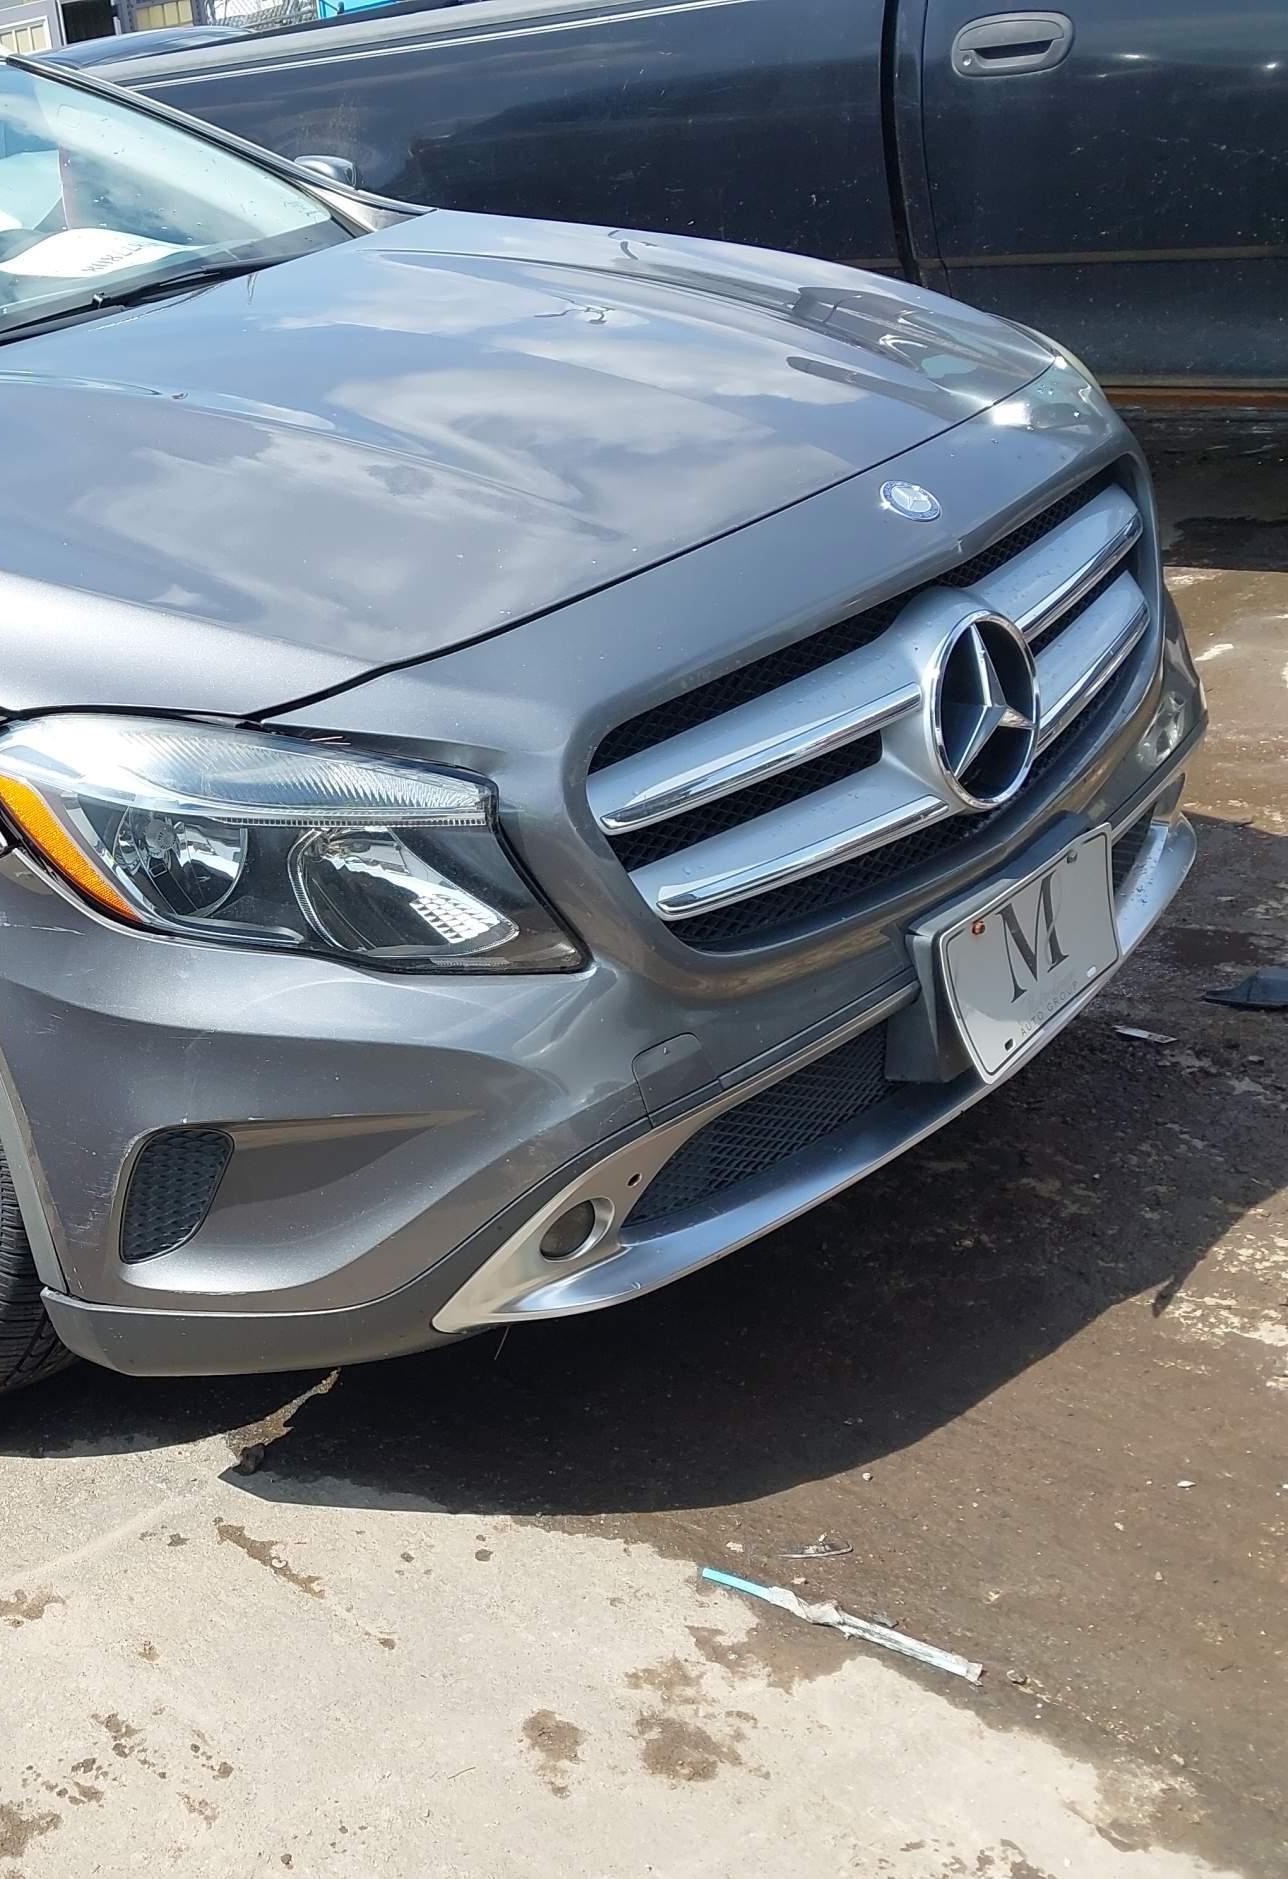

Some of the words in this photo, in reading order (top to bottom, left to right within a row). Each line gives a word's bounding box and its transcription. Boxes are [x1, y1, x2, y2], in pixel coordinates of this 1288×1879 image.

[995, 870, 1070, 1004] M
[1020, 1011, 1045, 1037] AUTO
[1046, 980, 1079, 1012] GROUP
